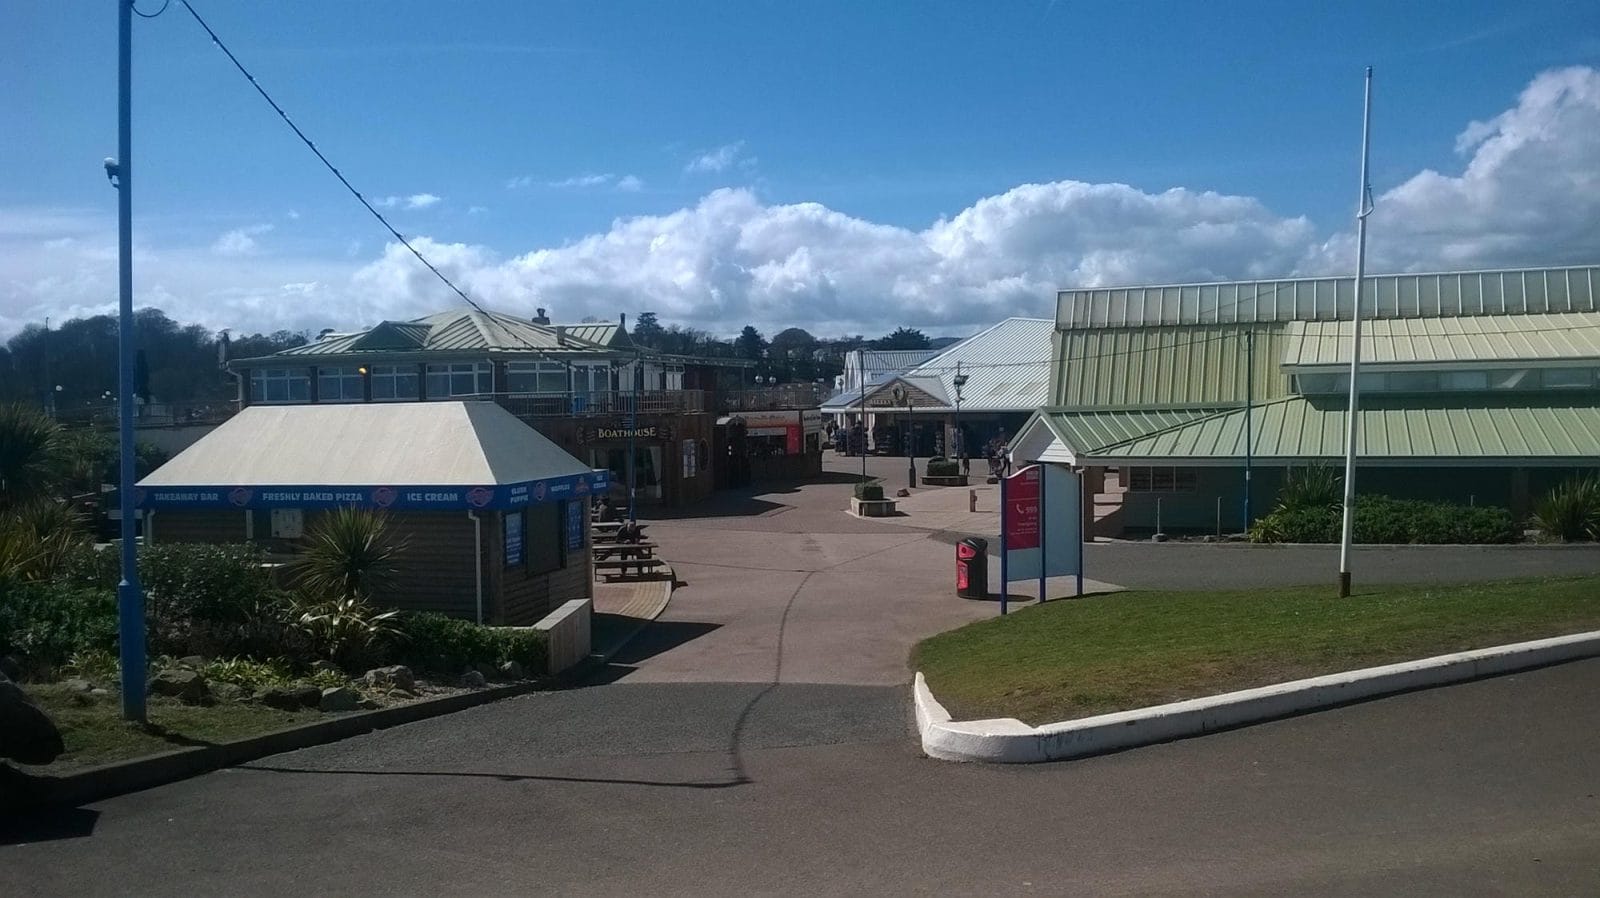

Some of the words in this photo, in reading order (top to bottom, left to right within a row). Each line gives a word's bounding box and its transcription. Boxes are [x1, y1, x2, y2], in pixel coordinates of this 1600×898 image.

[598, 427, 656, 438] BOATHOUSE
[154, 493, 198, 501] TAKEAWAY
[201, 493, 218, 501] BAR
[262, 492, 300, 501] FRESHLY
[303, 492, 333, 501] BAKED
[336, 493, 363, 501] PIZZA
[407, 493, 422, 501] ICE
[425, 493, 458, 501] CREAM
